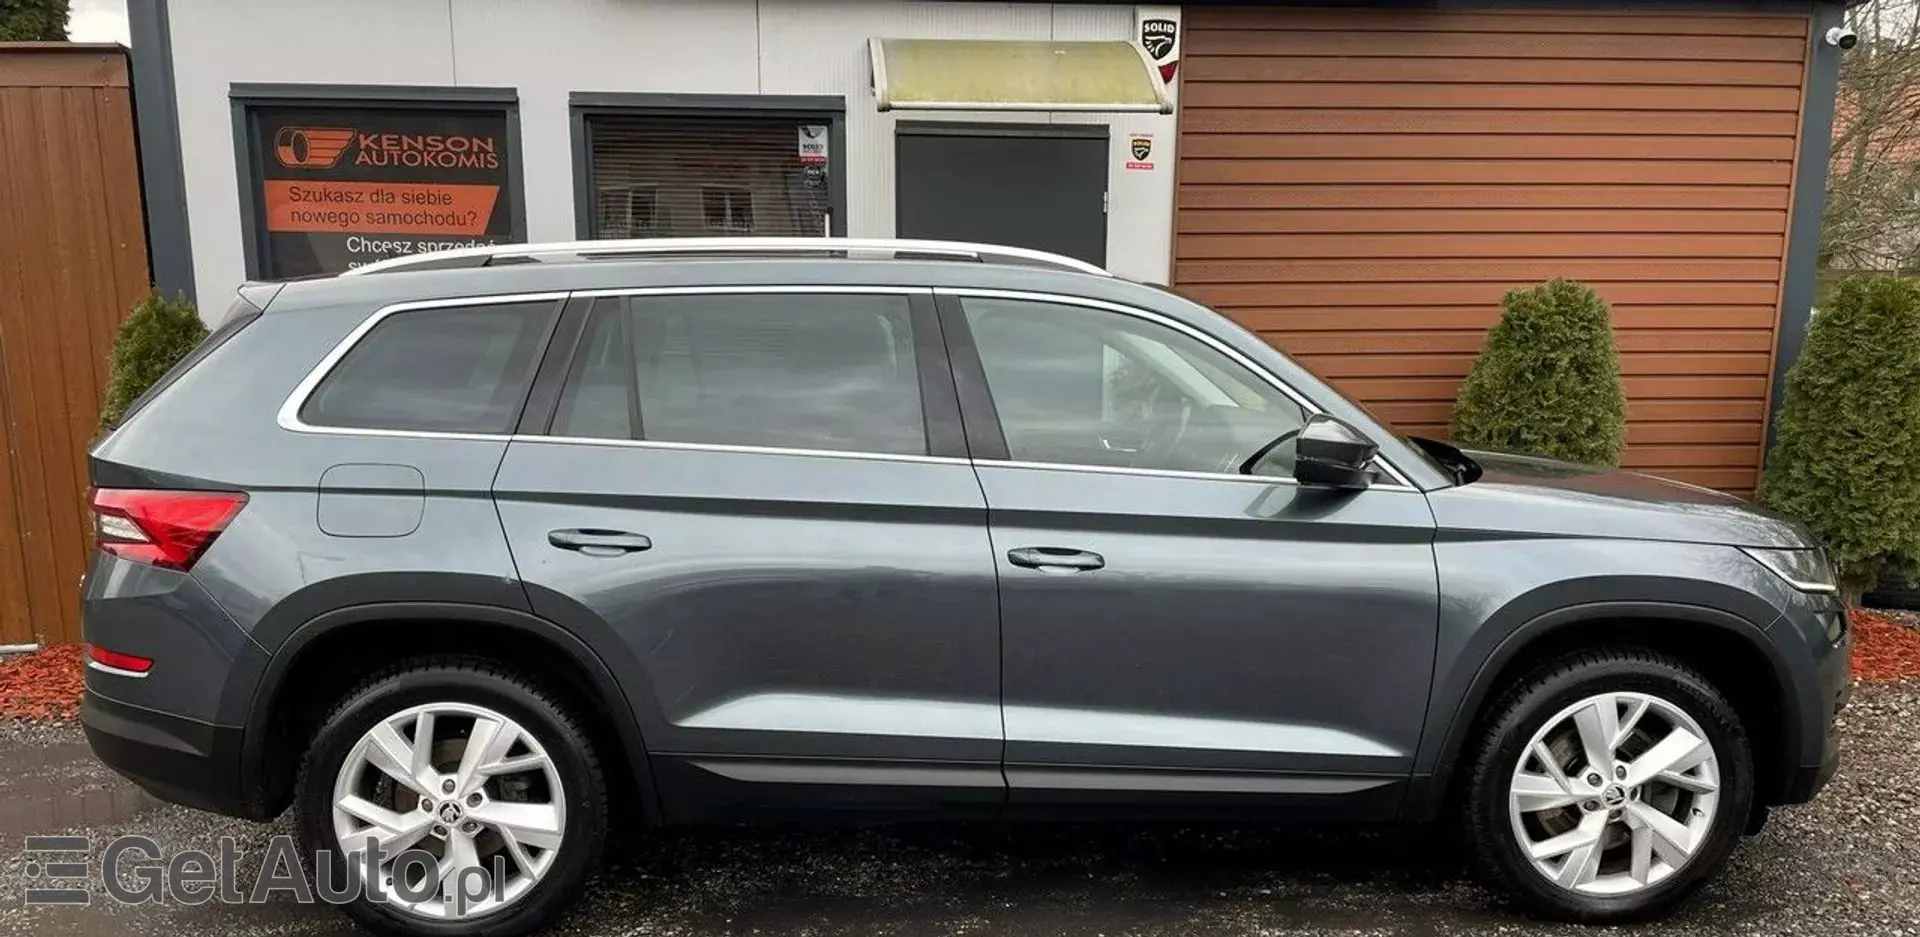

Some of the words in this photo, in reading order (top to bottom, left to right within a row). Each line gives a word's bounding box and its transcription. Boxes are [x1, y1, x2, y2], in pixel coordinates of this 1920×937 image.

[1144, 22, 1175, 33] SOLID
[358, 132, 493, 153] KENSON
[354, 151, 499, 169] AUTOKOMIS
[289, 186, 364, 203] Szukasz
[369, 186, 395, 204] dla
[400, 187, 453, 205] siebie
[290, 210, 360, 228] nowego
[366, 210, 477, 227] samochodu?
[346, 236, 412, 254] Chcesz
